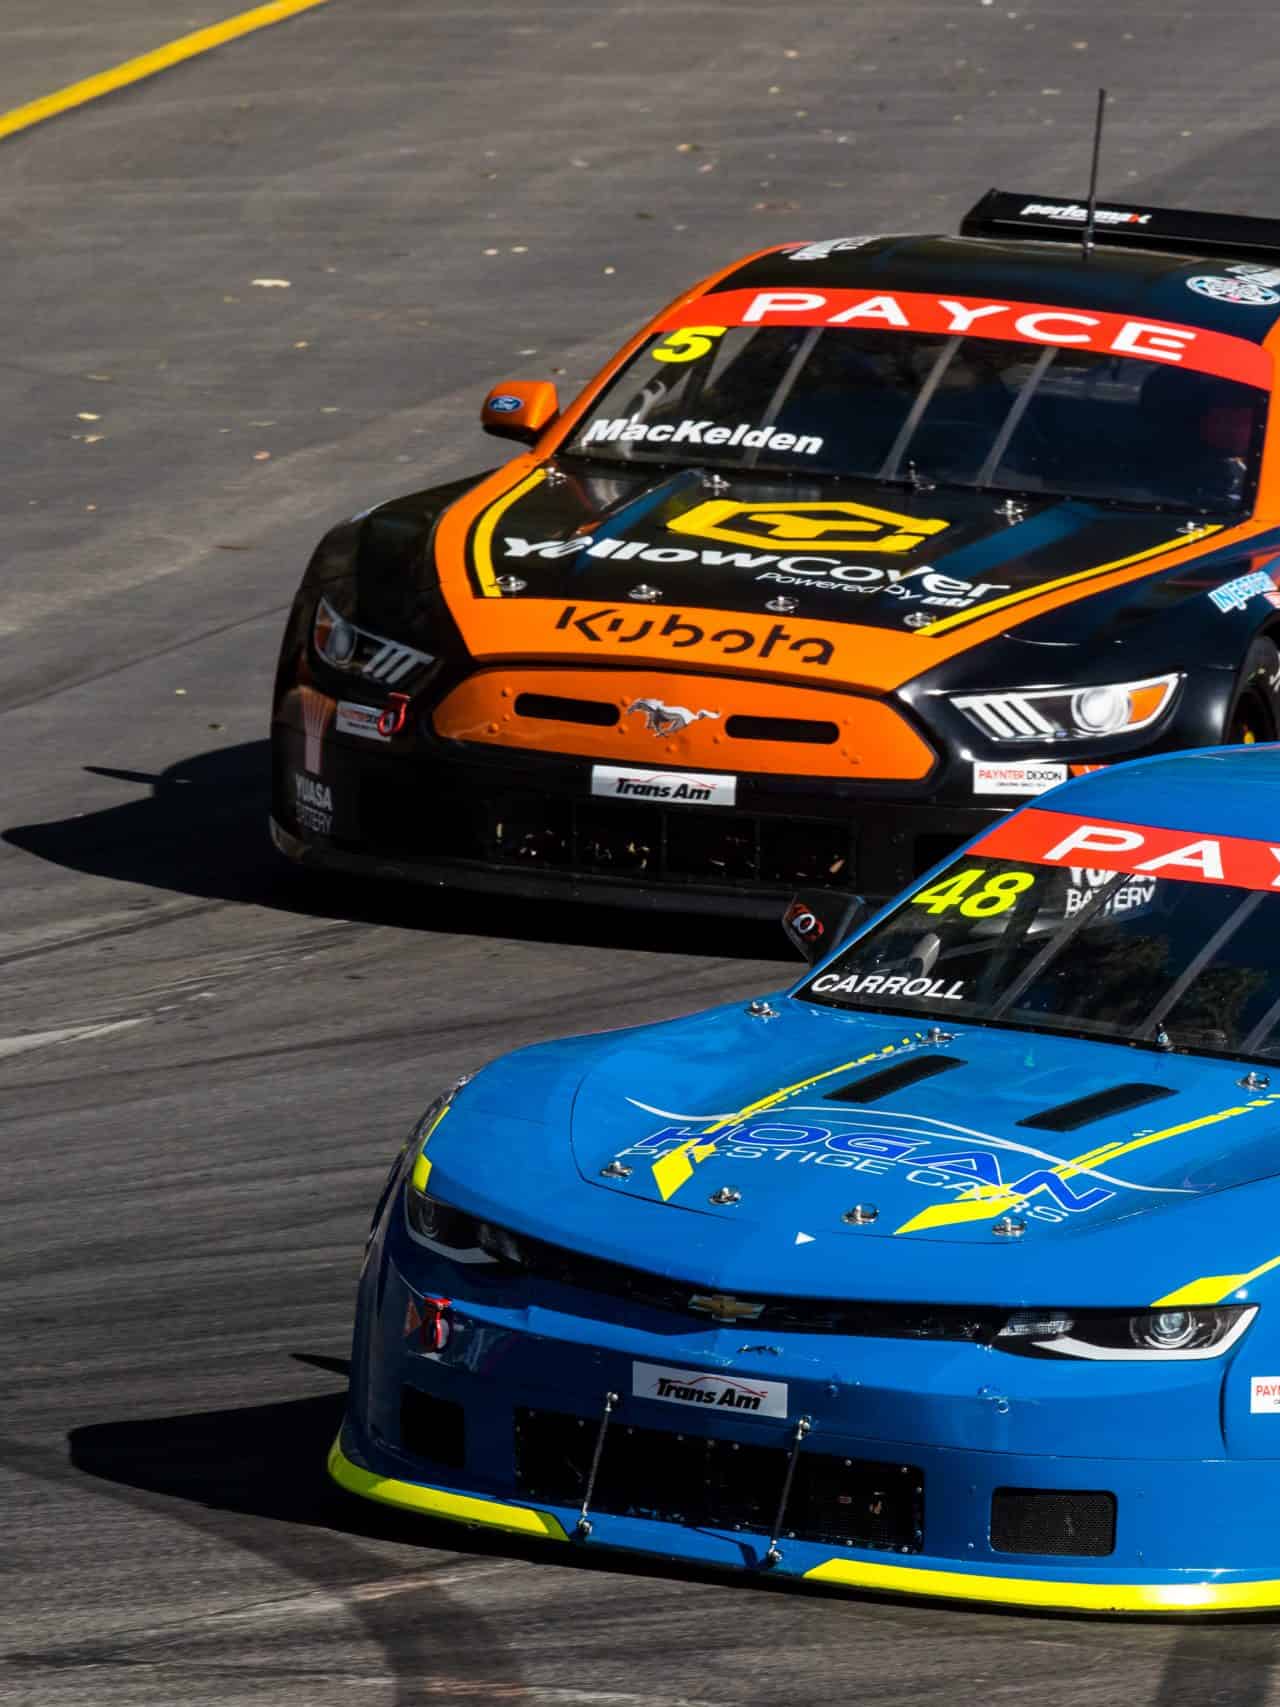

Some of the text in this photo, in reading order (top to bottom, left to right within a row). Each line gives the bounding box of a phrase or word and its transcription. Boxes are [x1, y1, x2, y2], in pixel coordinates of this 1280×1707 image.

[1019, 203, 1153, 224] perfomax
[742, 292, 1197, 361] PAYCE
[651, 326, 727, 363] 5
[584, 417, 824, 455] MacKelden
[503, 535, 1011, 598] YellowCover
[755, 572, 884, 594] Powered
[884, 583, 924, 601] by
[555, 606, 836, 666] Kubota
[616, 778, 711, 801] Trans Am
[978, 769, 1063, 781] PAYNTER DIXON
[911, 869, 1035, 918] 48
[1064, 884, 1156, 918] BAERY
[811, 973, 964, 1000] CARROLL
[614, 1145, 899, 1176] PSTIGE
[635, 1122, 1117, 1212] HOGAN
[656, 1377, 761, 1411] Trans Am
